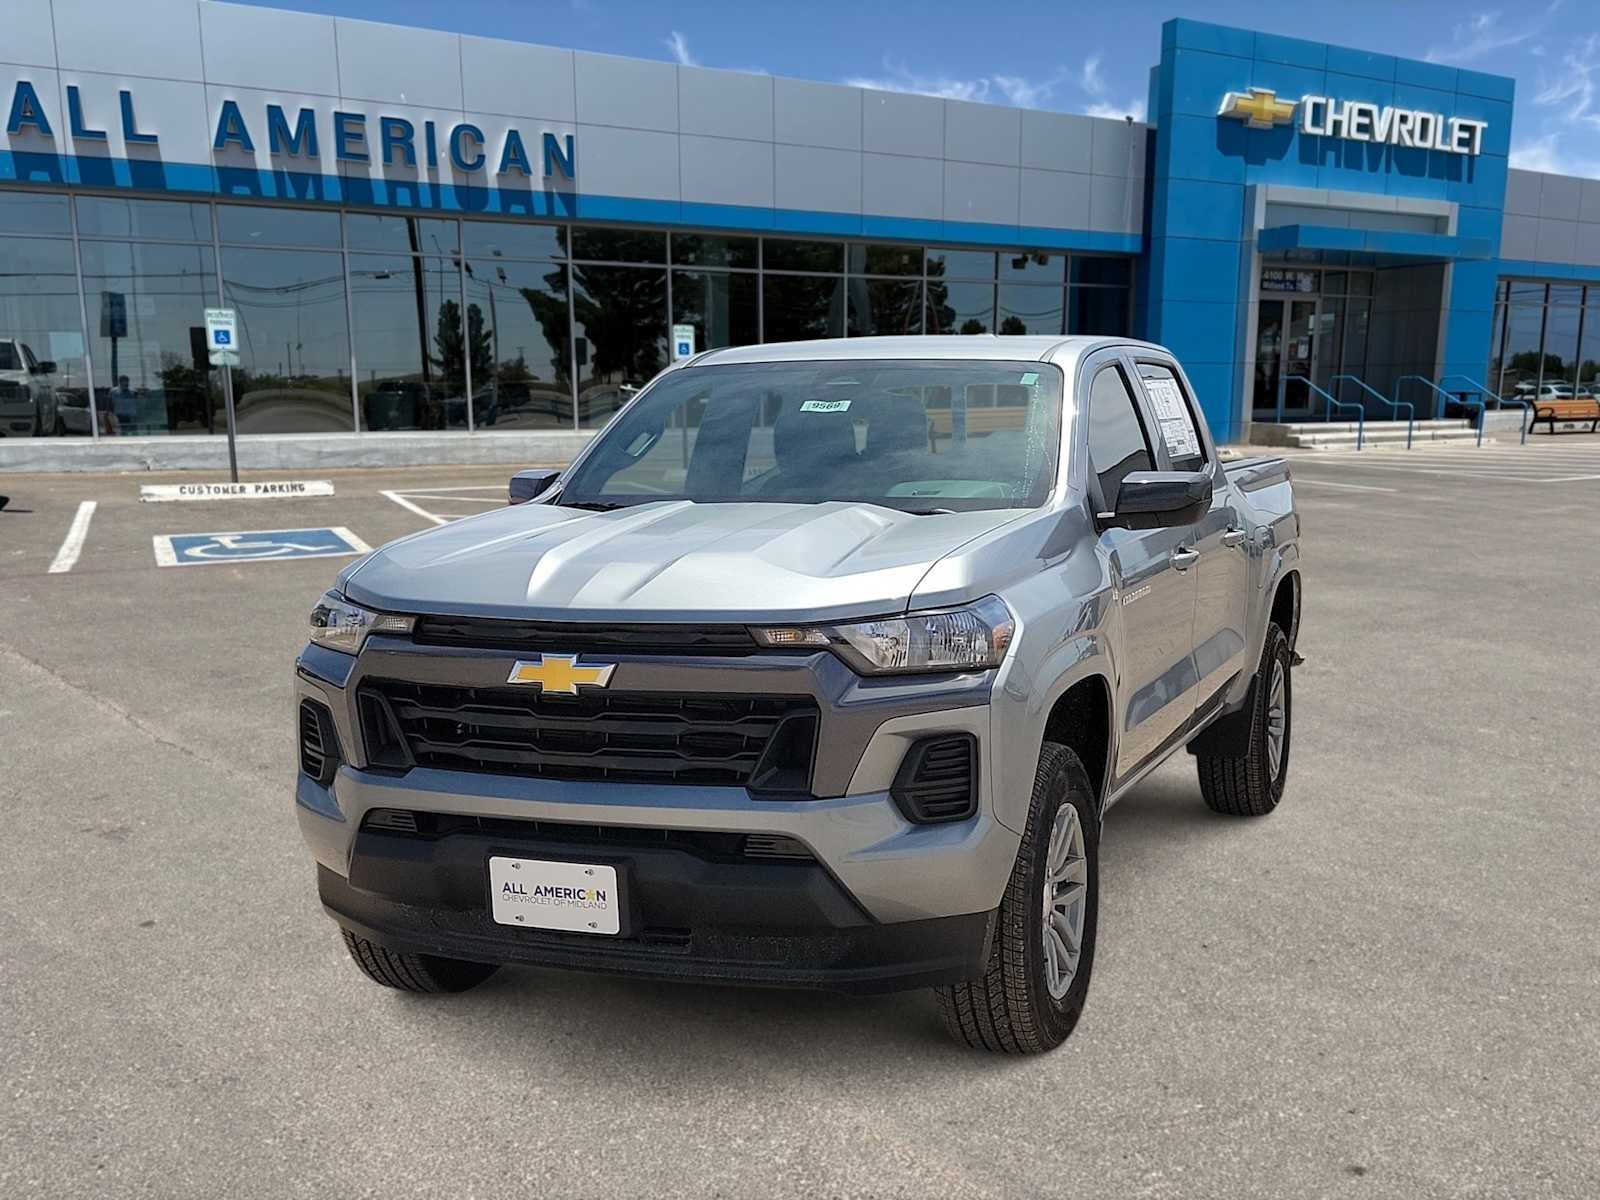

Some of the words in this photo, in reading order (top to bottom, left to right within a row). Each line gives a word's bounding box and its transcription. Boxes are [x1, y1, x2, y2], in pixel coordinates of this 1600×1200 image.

[6, 80, 158, 144] ALL
[213, 100, 576, 179] AMERICAN
[1301, 94, 1489, 155] CHEVROLET
[179, 485, 247, 495] CUSTOMER
[255, 483, 306, 493] PARKING
[502, 882, 528, 894] ALL
[534, 885, 606, 901] AMERICN
[502, 894, 551, 905] CHEVROLET
[553, 899, 565, 908] OF
[567, 899, 608, 910] MIDLAND
